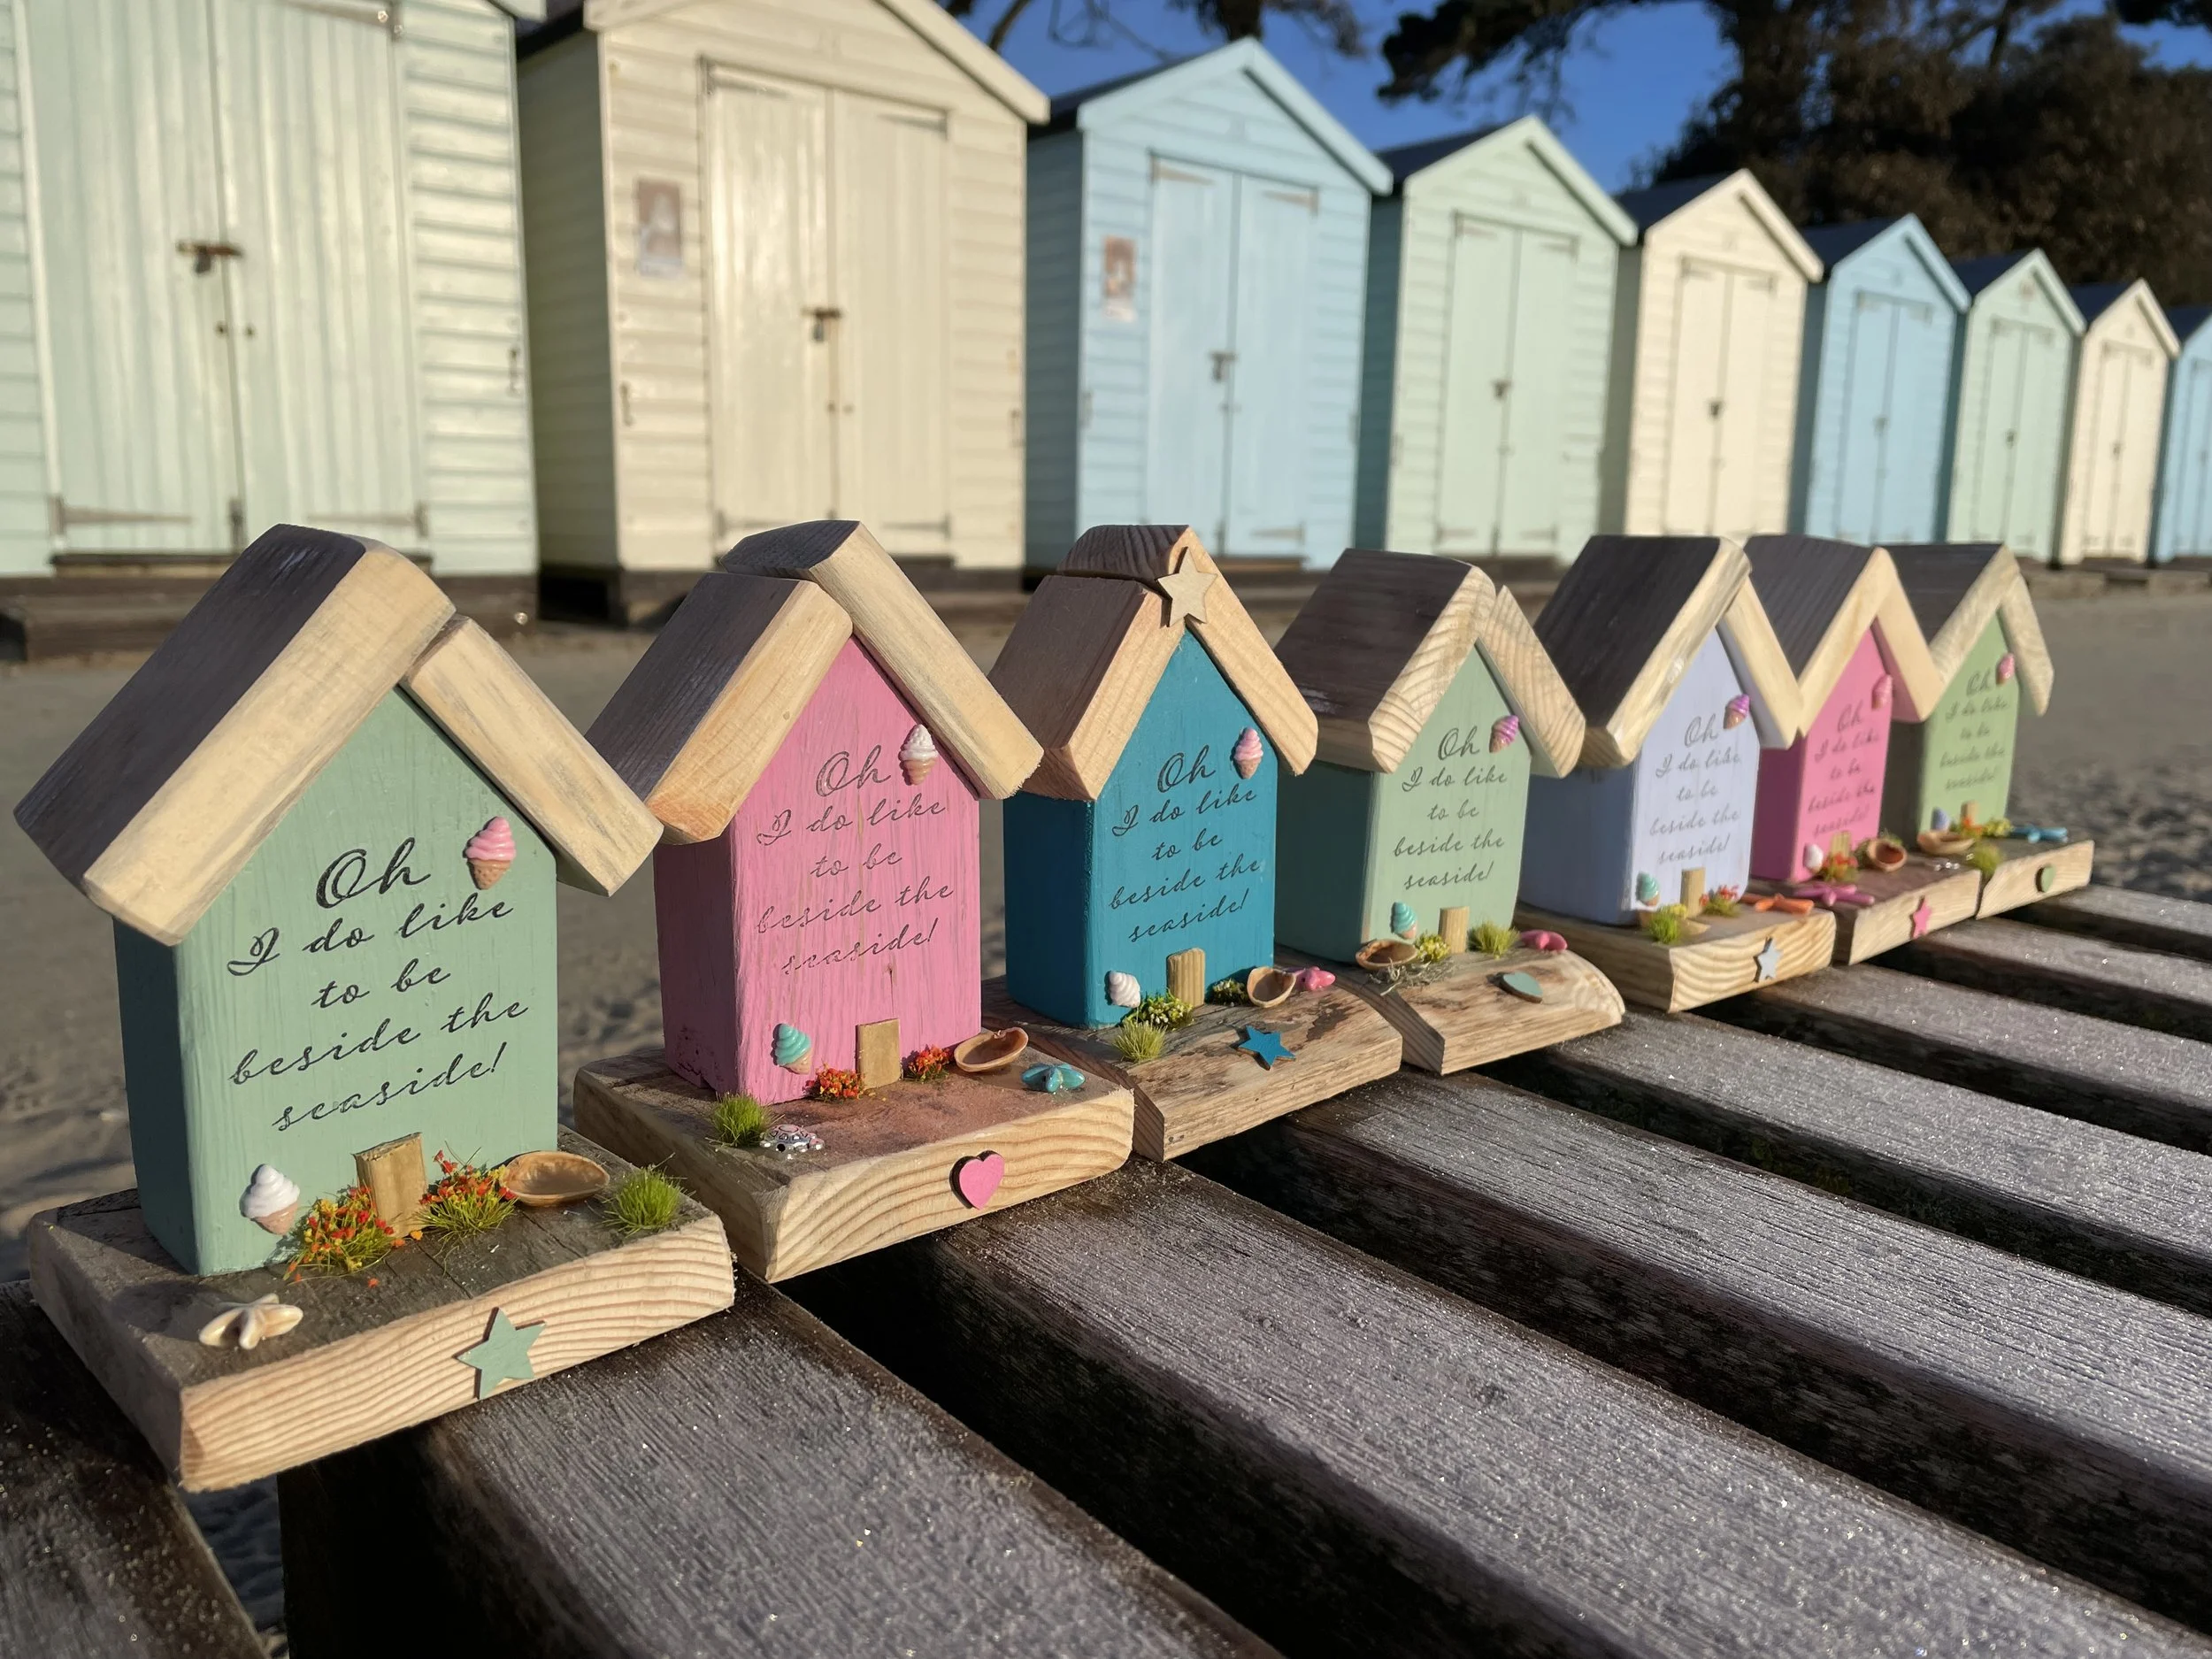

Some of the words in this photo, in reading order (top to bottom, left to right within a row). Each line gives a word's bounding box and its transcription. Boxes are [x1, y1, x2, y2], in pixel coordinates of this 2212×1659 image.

[1438, 726, 1480, 761] Oh
[1684, 713, 1719, 748] Oh
[816, 744, 891, 797] Oh
[1157, 744, 1217, 793] Oh
[1402, 766, 1423, 792] I
[1429, 767, 1455, 786] do
[1463, 764, 1507, 786] like
[1655, 754, 1673, 779] I
[1678, 753, 1698, 771] do
[757, 809, 792, 846] I
[806, 805, 854, 832] do
[867, 793, 946, 826] like
[1112, 804, 1139, 836] I
[1149, 799, 1186, 823] do
[1196, 783, 1257, 814] like
[1427, 804, 1449, 820] to
[1457, 799, 1480, 818] be
[1649, 810, 1706, 836] beside
[1712, 803, 1740, 824] the
[810, 856, 849, 878] to
[862, 843, 902, 870] be
[1152, 842, 1181, 860] to
[1192, 828, 1223, 851] be
[1394, 833, 1463, 857] beside
[1471, 828, 1505, 849] the
[1657, 833, 1730, 864] seaside!
[316, 837, 431, 909] Oh
[1109, 868, 1205, 910] beside
[1216, 853, 1260, 881] the
[1404, 861, 1494, 890] seaside!
[756, 890, 882, 933] beside
[895, 876, 954, 906] the
[1129, 888, 1249, 942] seaside!
[227, 927, 280, 976] I
[303, 917, 374, 953] do
[396, 892, 514, 939] like
[781, 918, 939, 975] seaside!
[311, 980, 370, 1008] to
[390, 957, 450, 992] be
[228, 1018, 421, 1085] beside
[441, 992, 529, 1033] the
[272, 1041, 507, 1132] seaside!
